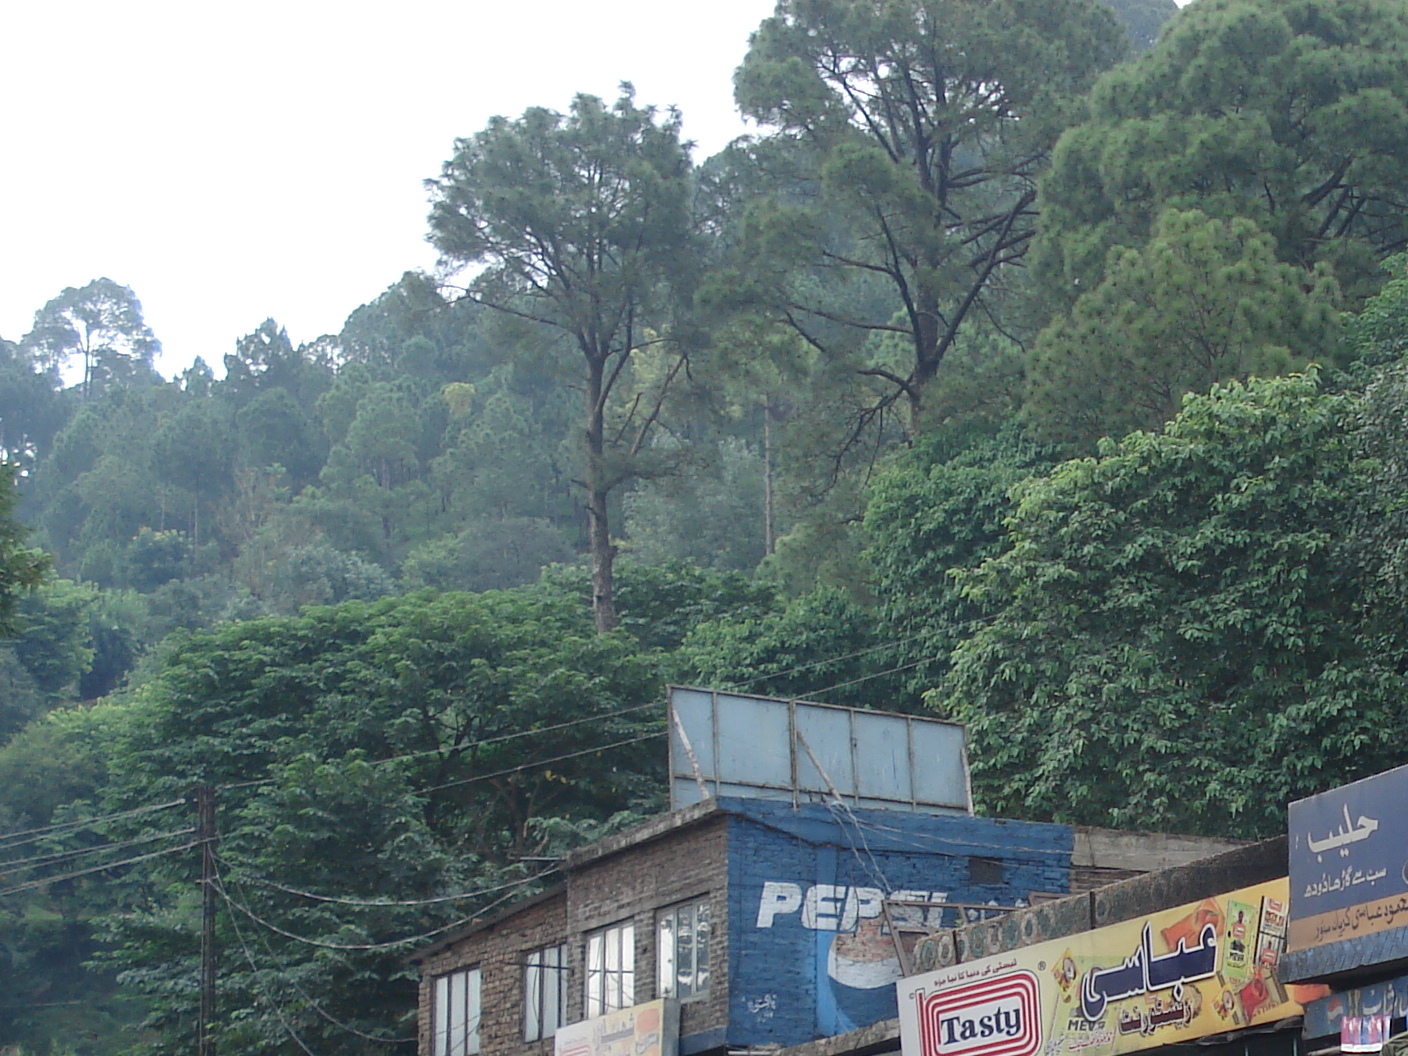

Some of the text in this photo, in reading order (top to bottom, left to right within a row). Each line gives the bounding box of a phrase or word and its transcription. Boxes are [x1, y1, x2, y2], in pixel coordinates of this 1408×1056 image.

[756, 881, 948, 931] PEPSI
[1081, 920, 1218, 1022] عباسی
[941, 1006, 1021, 1046] Tasty
